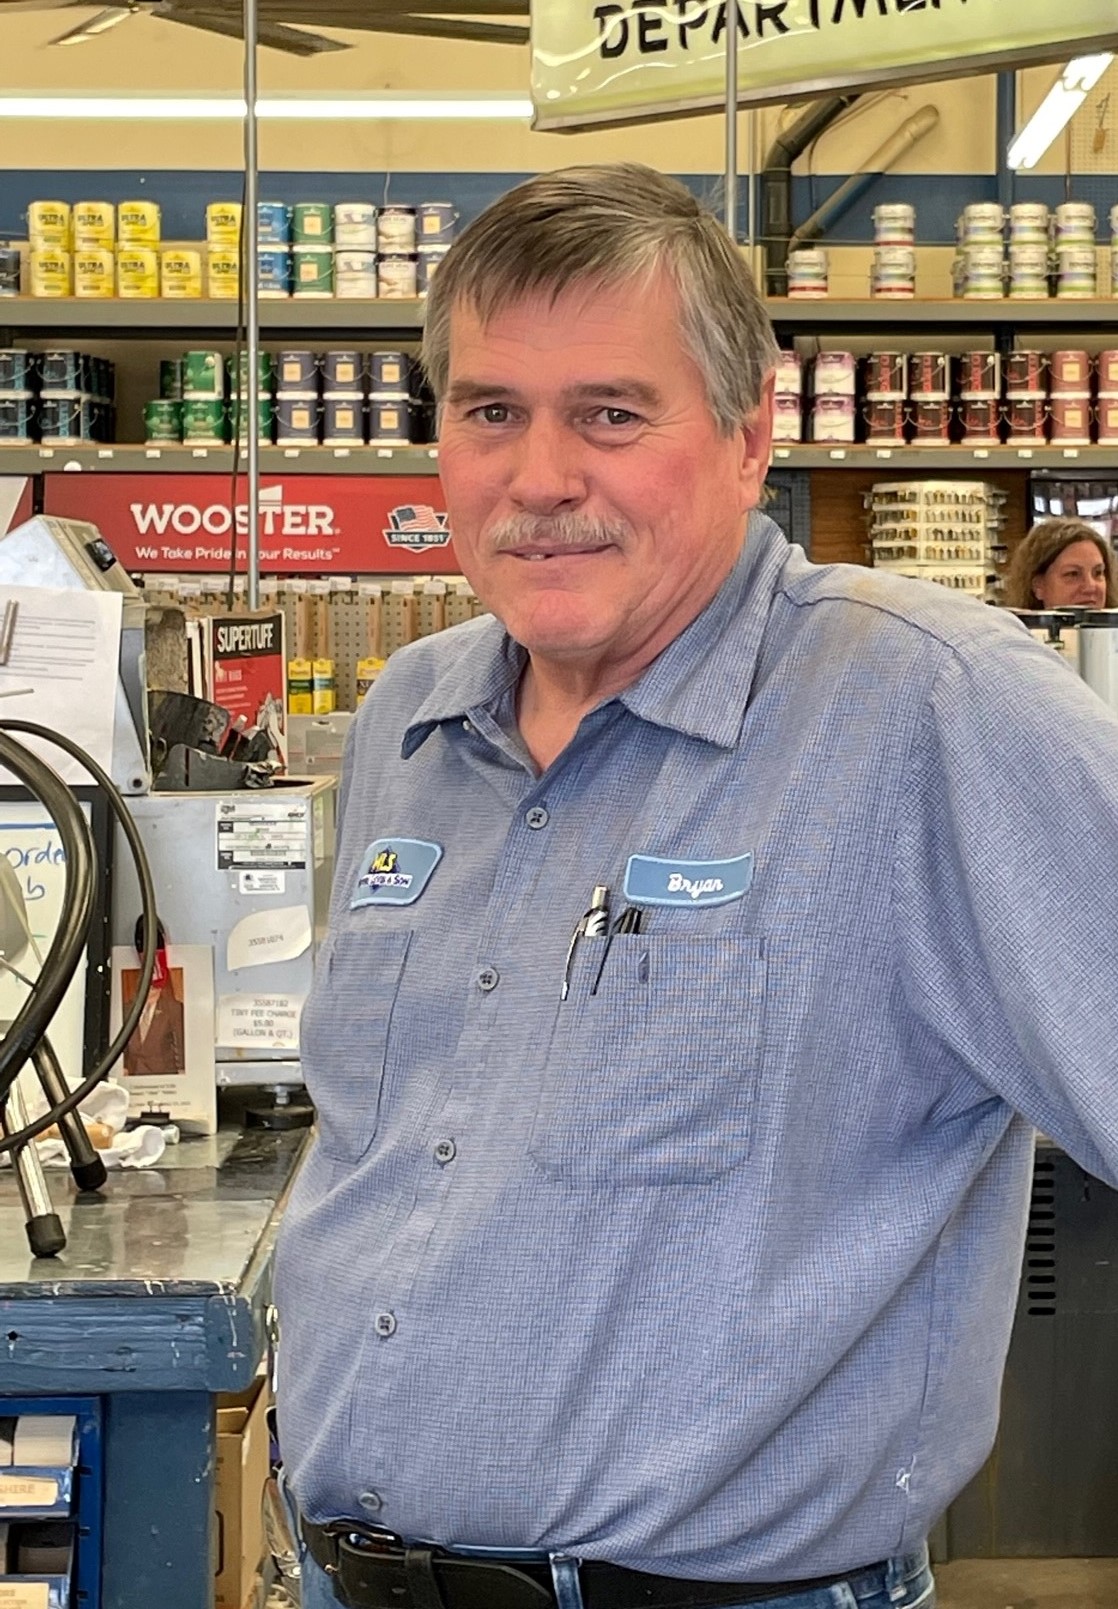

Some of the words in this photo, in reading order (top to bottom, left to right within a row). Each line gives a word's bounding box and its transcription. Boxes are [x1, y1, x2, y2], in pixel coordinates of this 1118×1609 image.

[130, 503, 335, 535] WOOSTER
[391, 534, 420, 543] SINCE
[135, 547, 158, 559] We
[161, 547, 192, 559] Take
[195, 547, 231, 559] Pride
[257, 550, 280, 560] our
[217, 623, 274, 653] SUPERTUFF
[667, 872, 723, 899] Bryan
